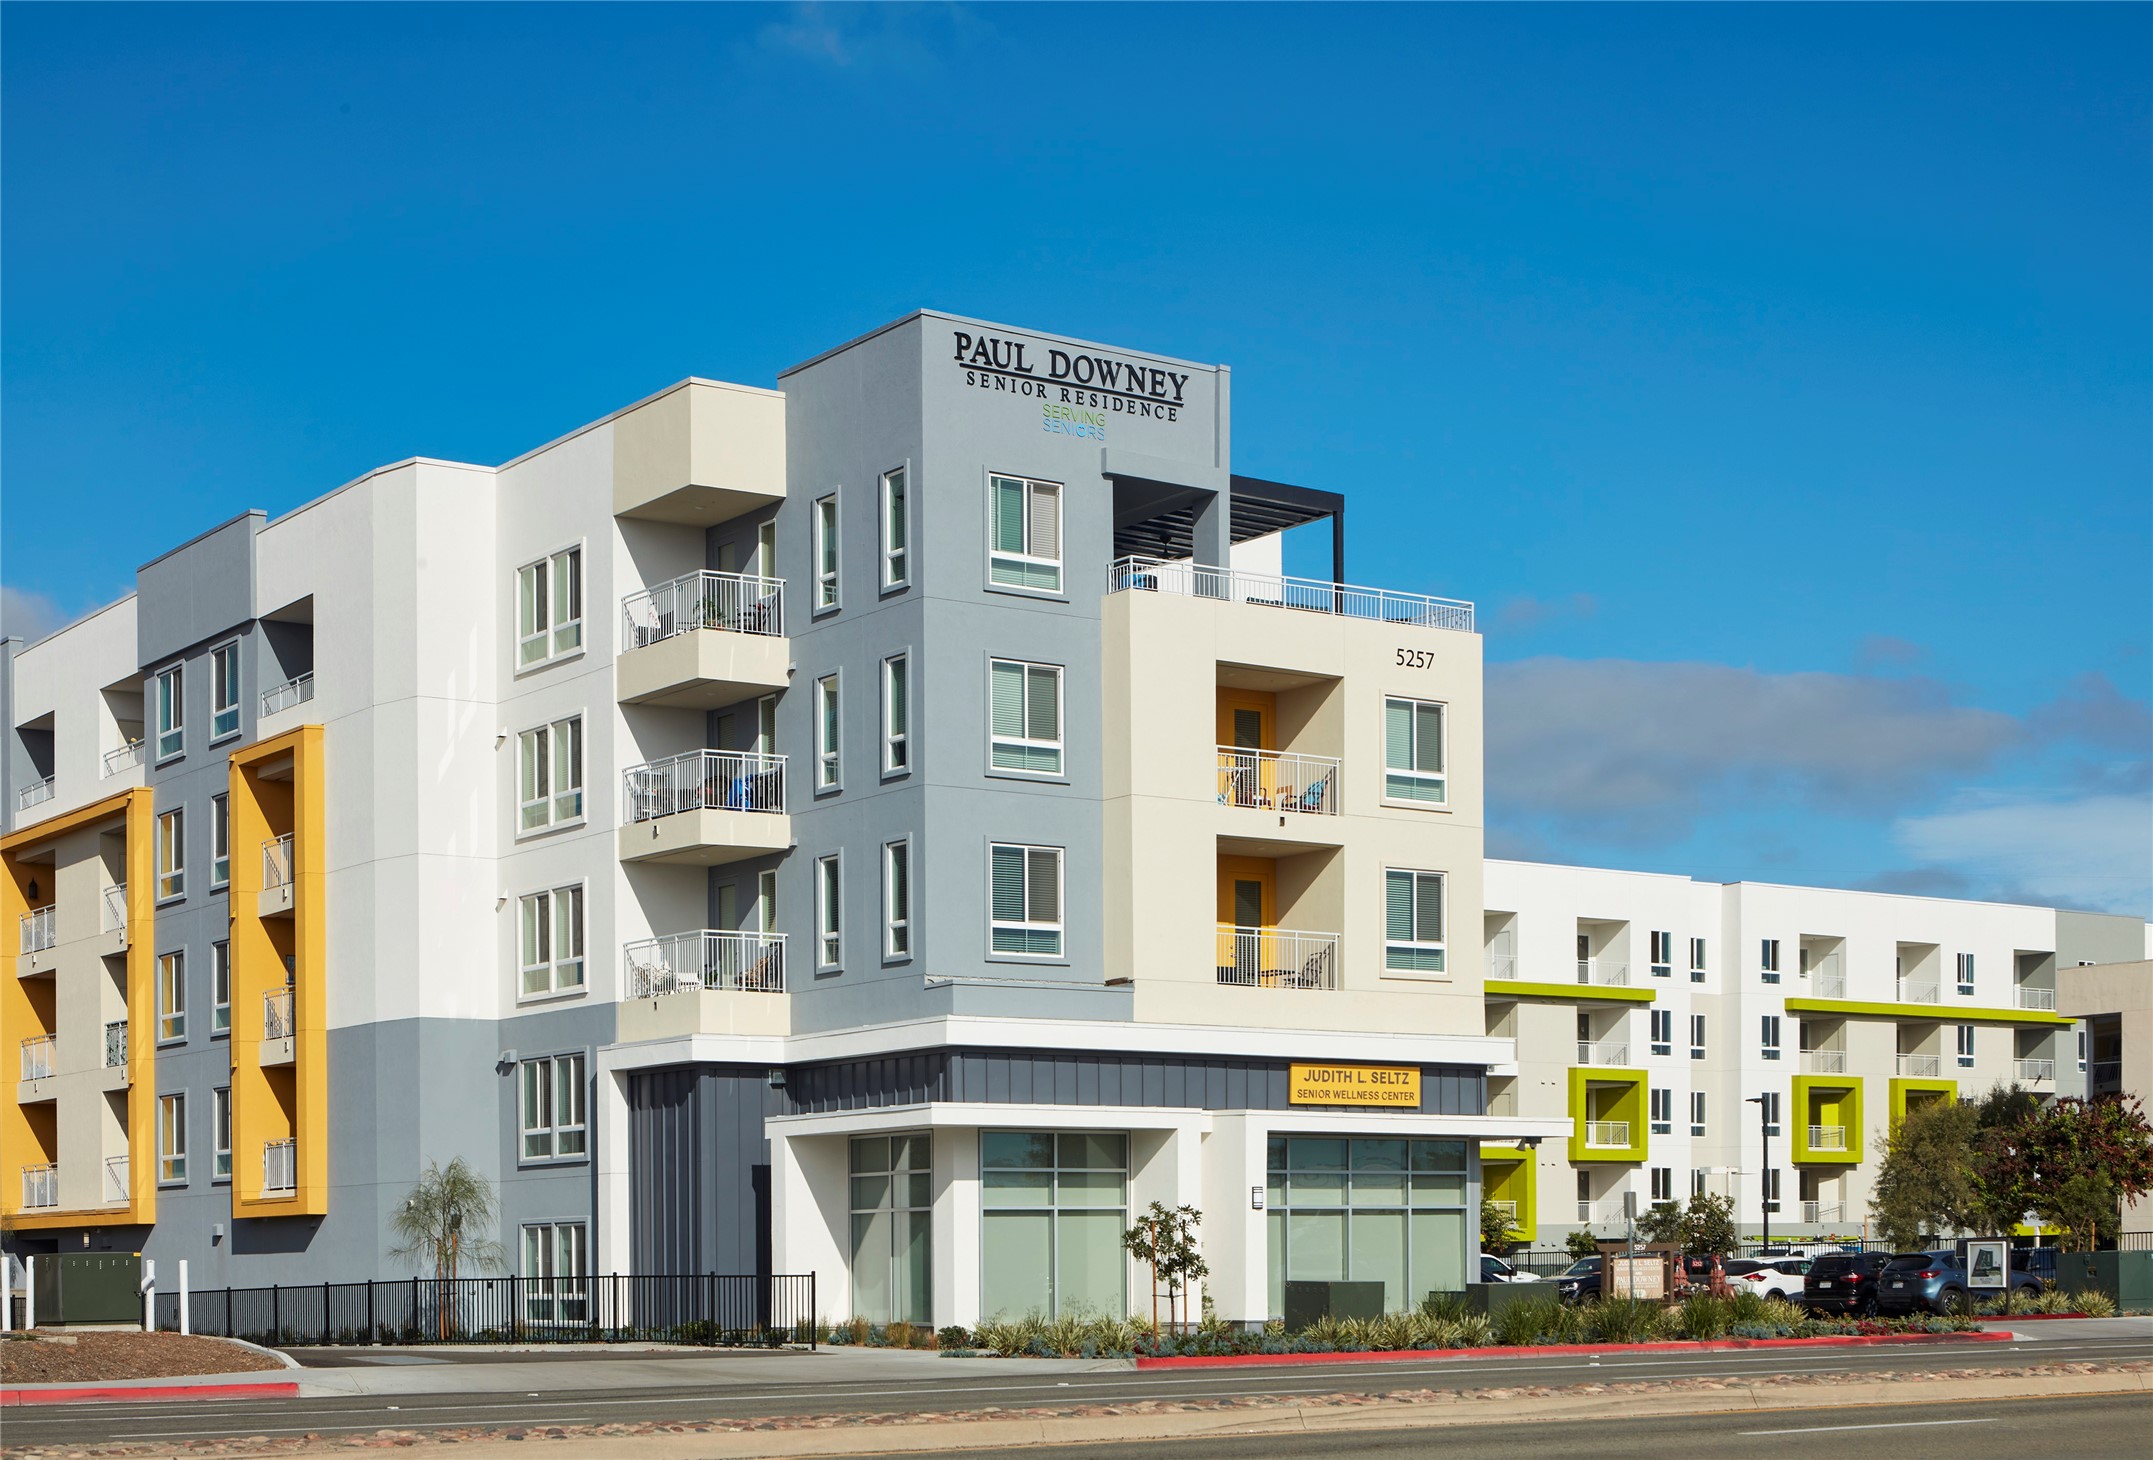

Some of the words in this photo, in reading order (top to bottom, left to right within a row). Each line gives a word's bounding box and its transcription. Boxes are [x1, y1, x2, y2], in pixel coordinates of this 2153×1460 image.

[954, 331, 1034, 374] PAUL
[1049, 349, 1189, 401] DOWNEY
[967, 371, 1047, 399] SENIOR
[1060, 388, 1178, 422] RESIDENCE
[1042, 403, 1106, 427] SERVING
[1042, 418, 1105, 441] SENIORS
[1396, 648, 1434, 670] 5257
[1304, 1069, 1352, 1083] JUDITH
[1358, 1071, 1367, 1084] L.
[1371, 1072, 1409, 1085] SELTZ
[1297, 1089, 1331, 1099] SENIOR
[1333, 1090, 1380, 1100] WELLNESS
[1381, 1091, 1415, 1101] CENTER
[1633, 1275, 1661, 1283] DOWNEY
